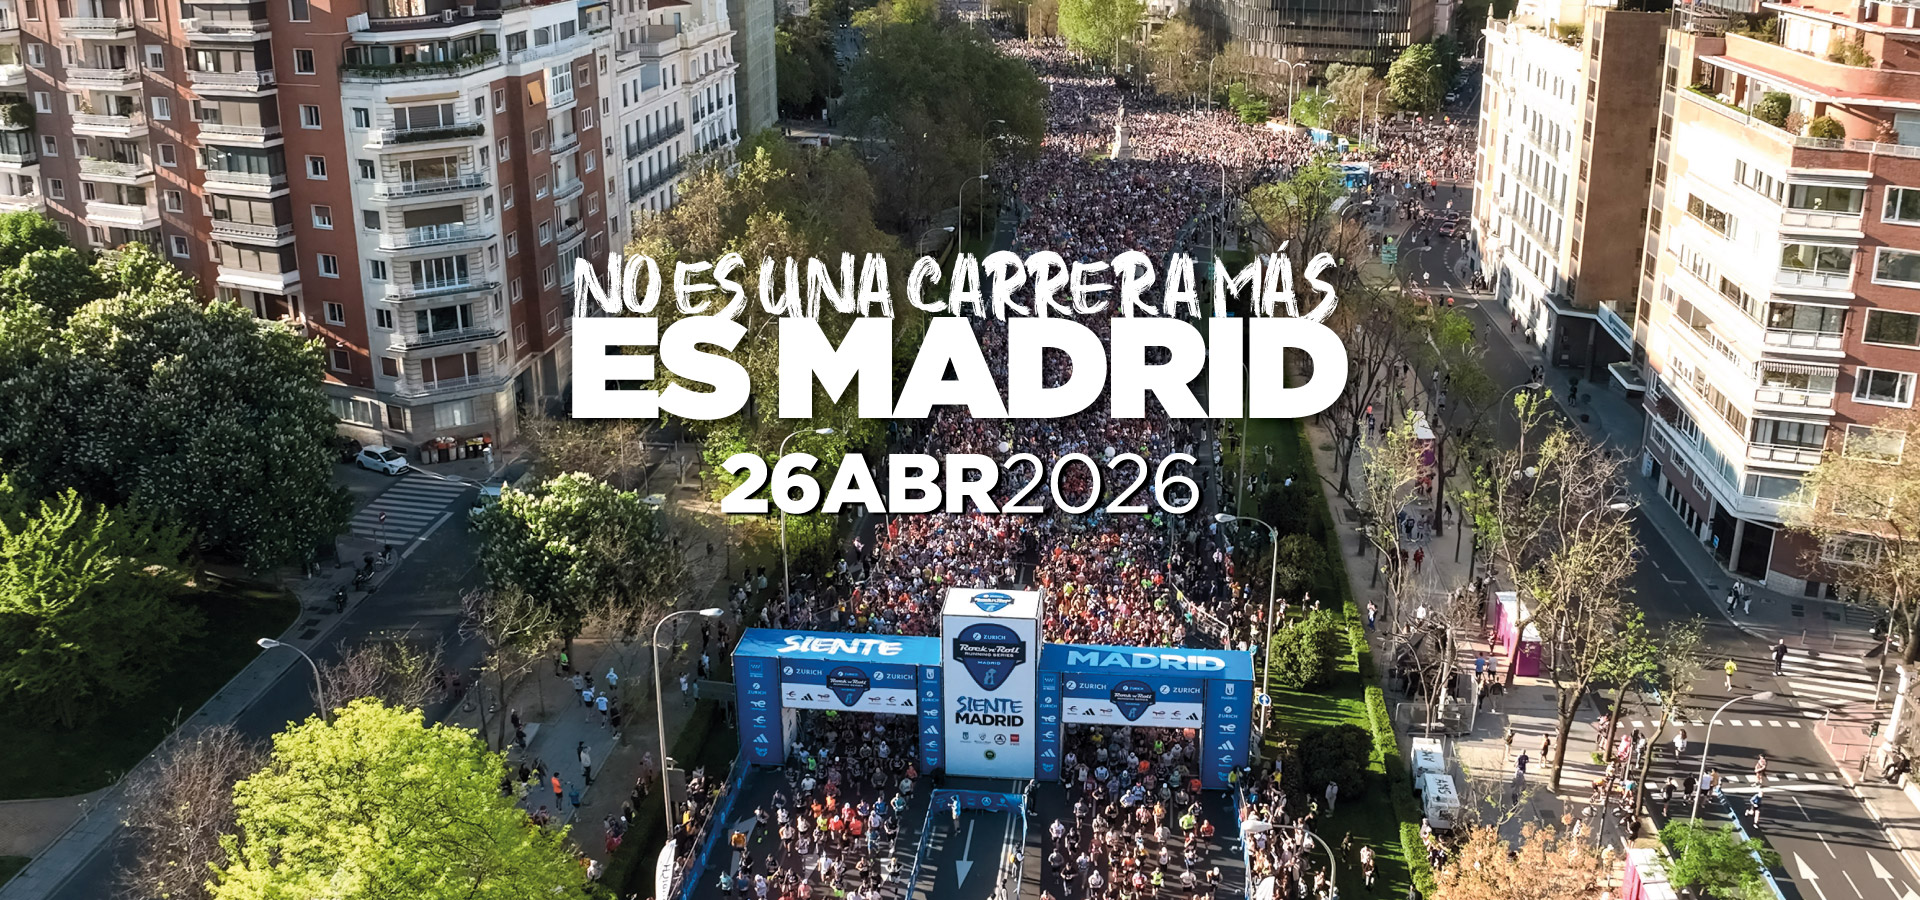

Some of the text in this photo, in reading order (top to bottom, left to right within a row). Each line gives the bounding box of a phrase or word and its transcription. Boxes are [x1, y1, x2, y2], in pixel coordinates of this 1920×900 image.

[777, 635, 903, 655] SIENTE
[960, 643, 988, 652] Rock
[996, 645, 1020, 654] Roll
[1067, 650, 1225, 671] MADRID
[957, 696, 1023, 713] SIENTE
[956, 712, 1023, 726] MADRID
